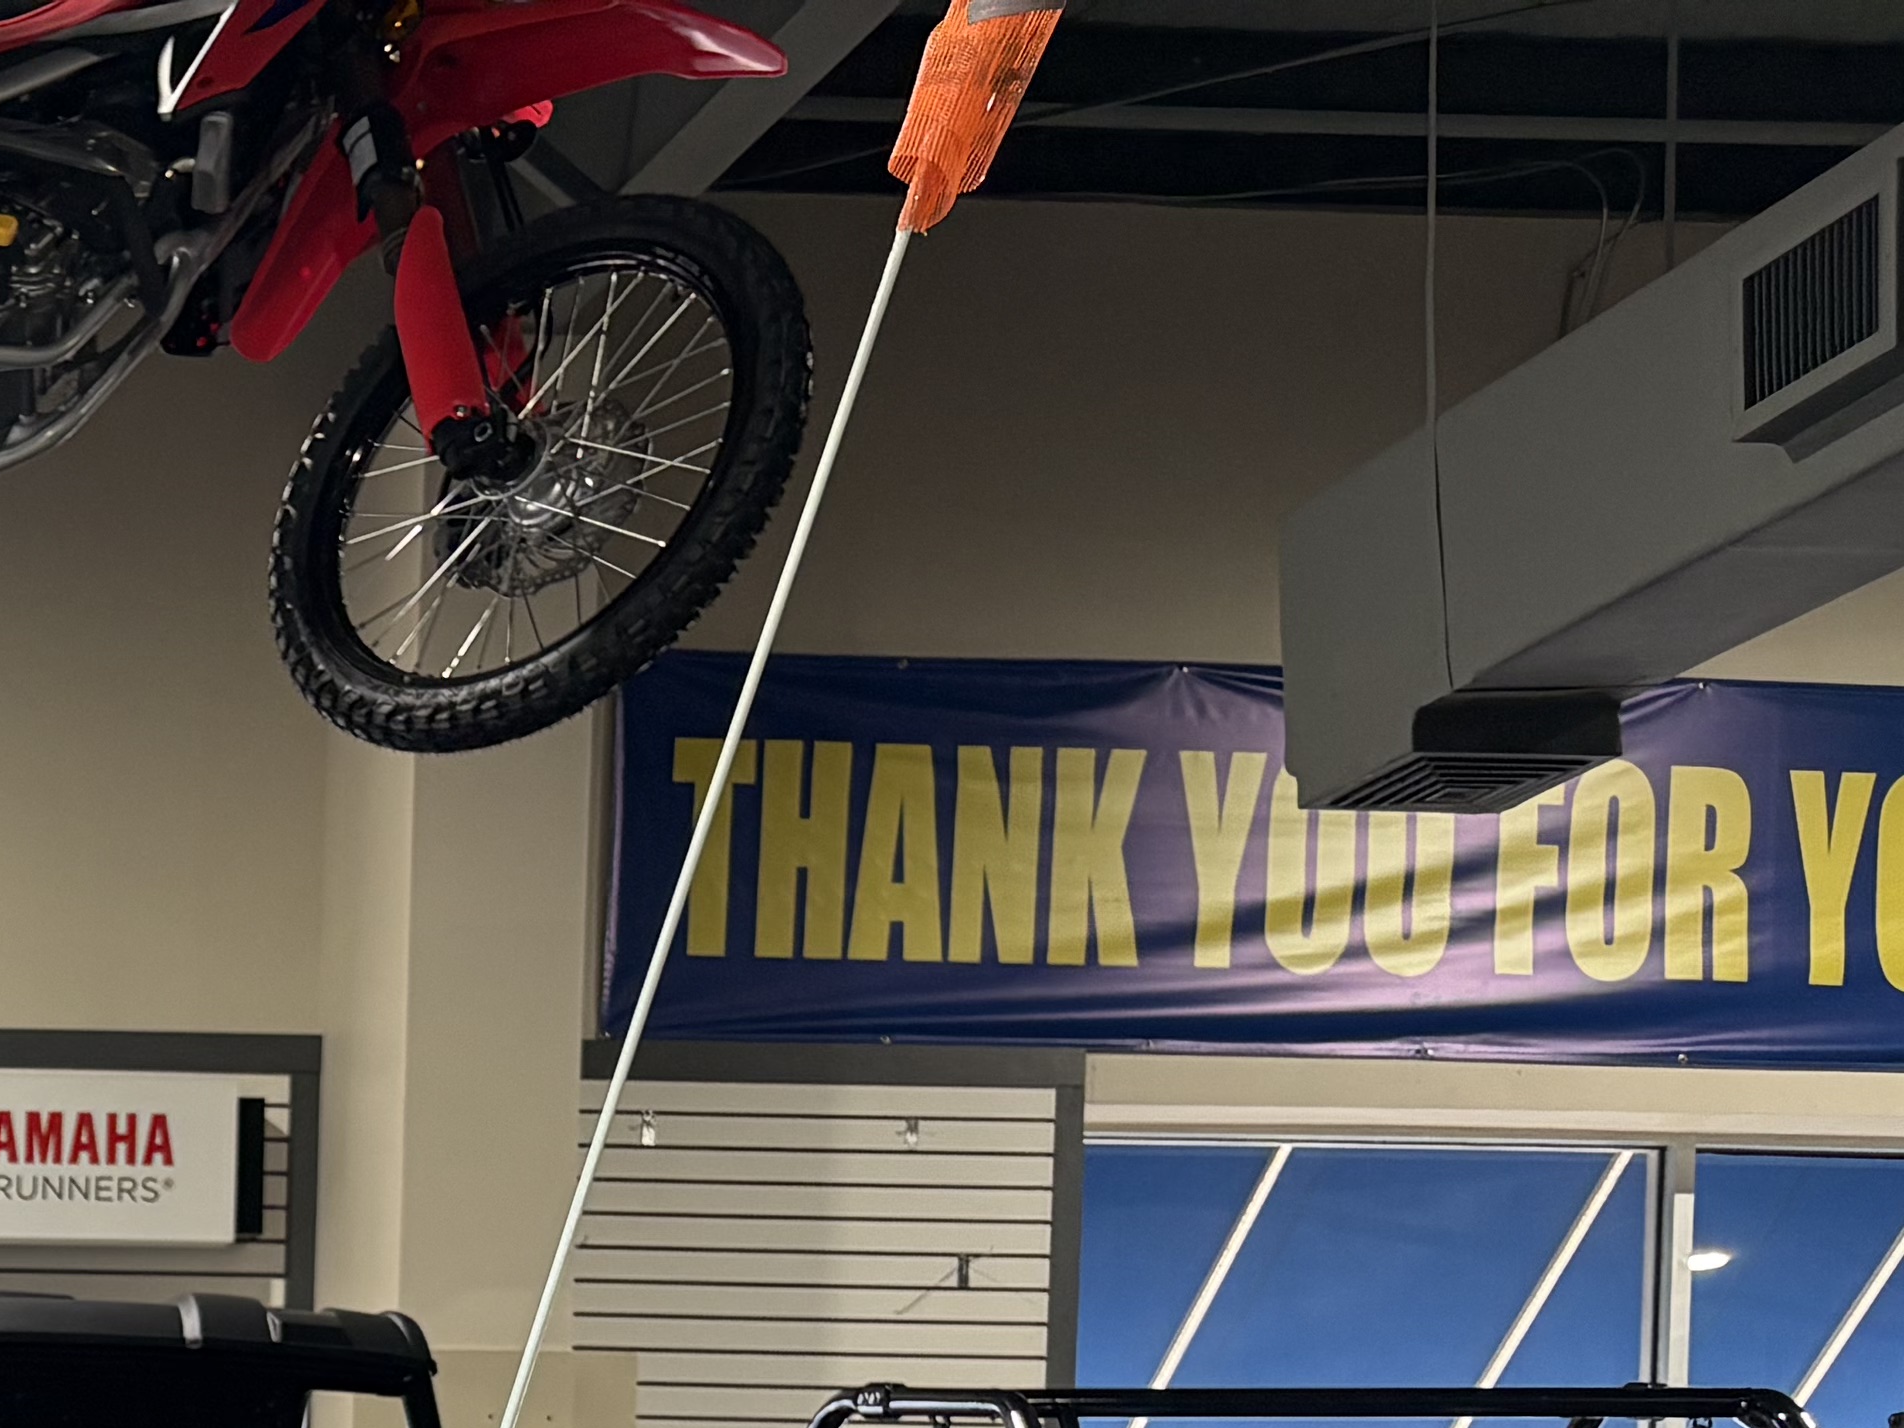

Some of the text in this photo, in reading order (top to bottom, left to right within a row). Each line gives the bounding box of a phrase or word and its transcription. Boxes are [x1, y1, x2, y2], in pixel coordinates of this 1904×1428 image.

[673, 737, 1149, 967] THANK
[1178, 750, 1455, 977] YOU
[1492, 761, 1751, 986] FOR
